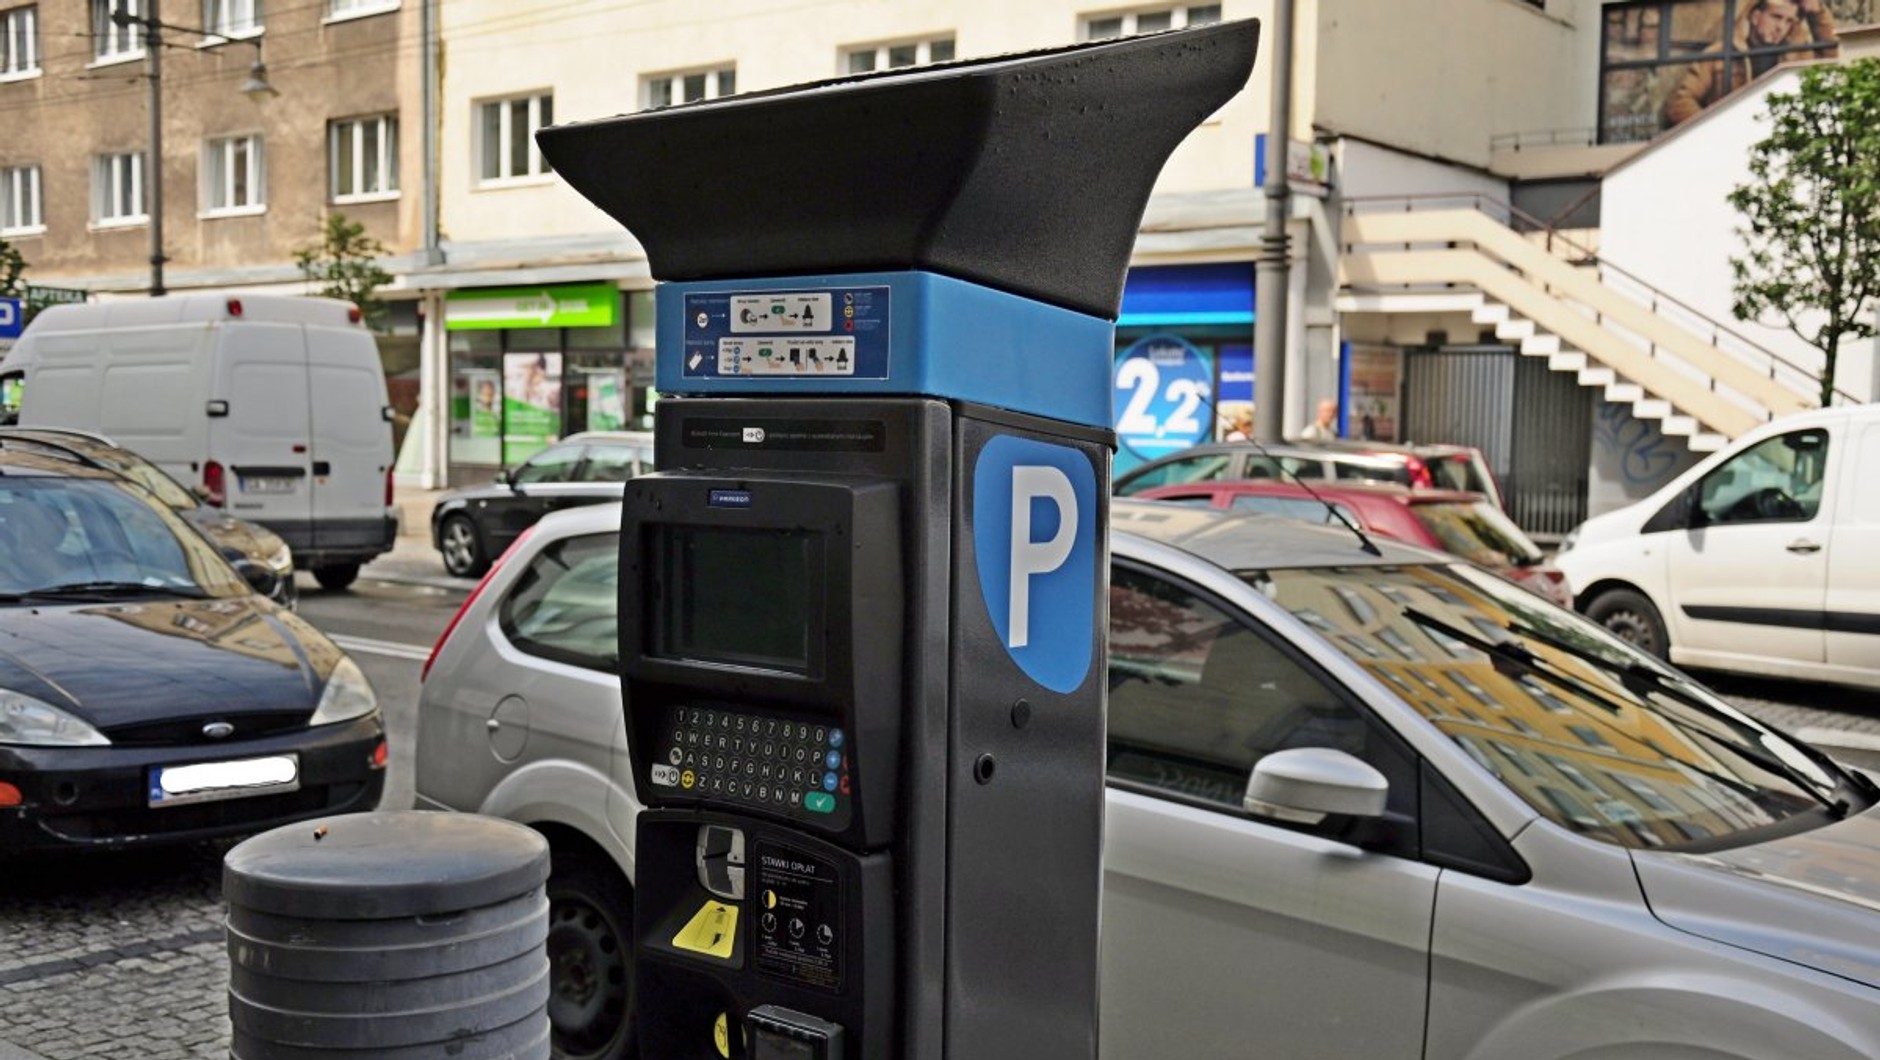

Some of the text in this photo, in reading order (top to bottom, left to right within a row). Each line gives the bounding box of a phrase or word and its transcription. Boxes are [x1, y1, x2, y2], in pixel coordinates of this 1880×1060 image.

[30, 287, 84, 302] APTEKA
[1009, 465, 1078, 648] P
[679, 710, 824, 742] 1 2 3 4 5 6 7 8 9 0
[675, 731, 821, 763] Q W E R T Y U I O P
[686, 753, 817, 785] A S D F G H J K L
[698, 776, 799, 803] Z X C V B N M
[761, 856, 790, 869] STAWKI
